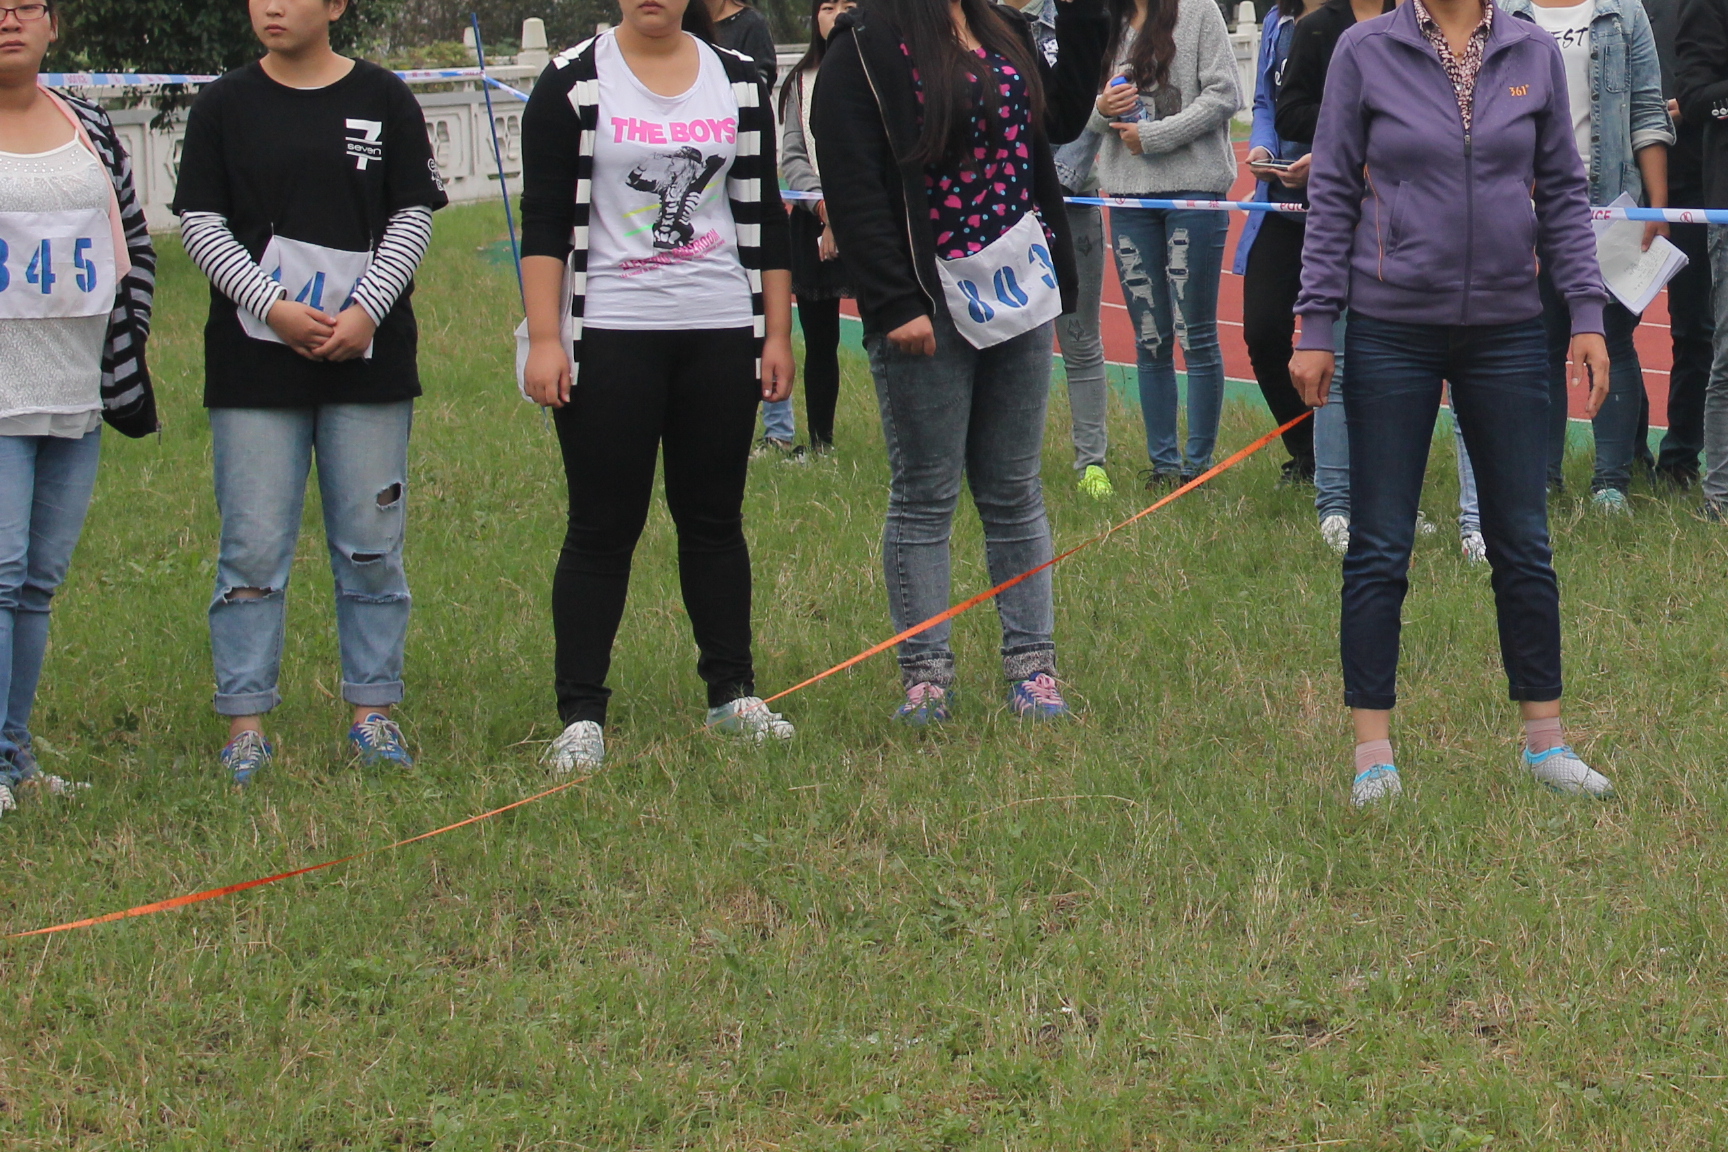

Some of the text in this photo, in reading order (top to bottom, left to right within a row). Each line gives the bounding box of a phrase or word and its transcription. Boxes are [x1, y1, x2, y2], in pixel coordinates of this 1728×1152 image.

[611, 117, 736, 144] THE BOYS
[347, 143, 381, 155] seven
[957, 244, 1058, 323] 803
